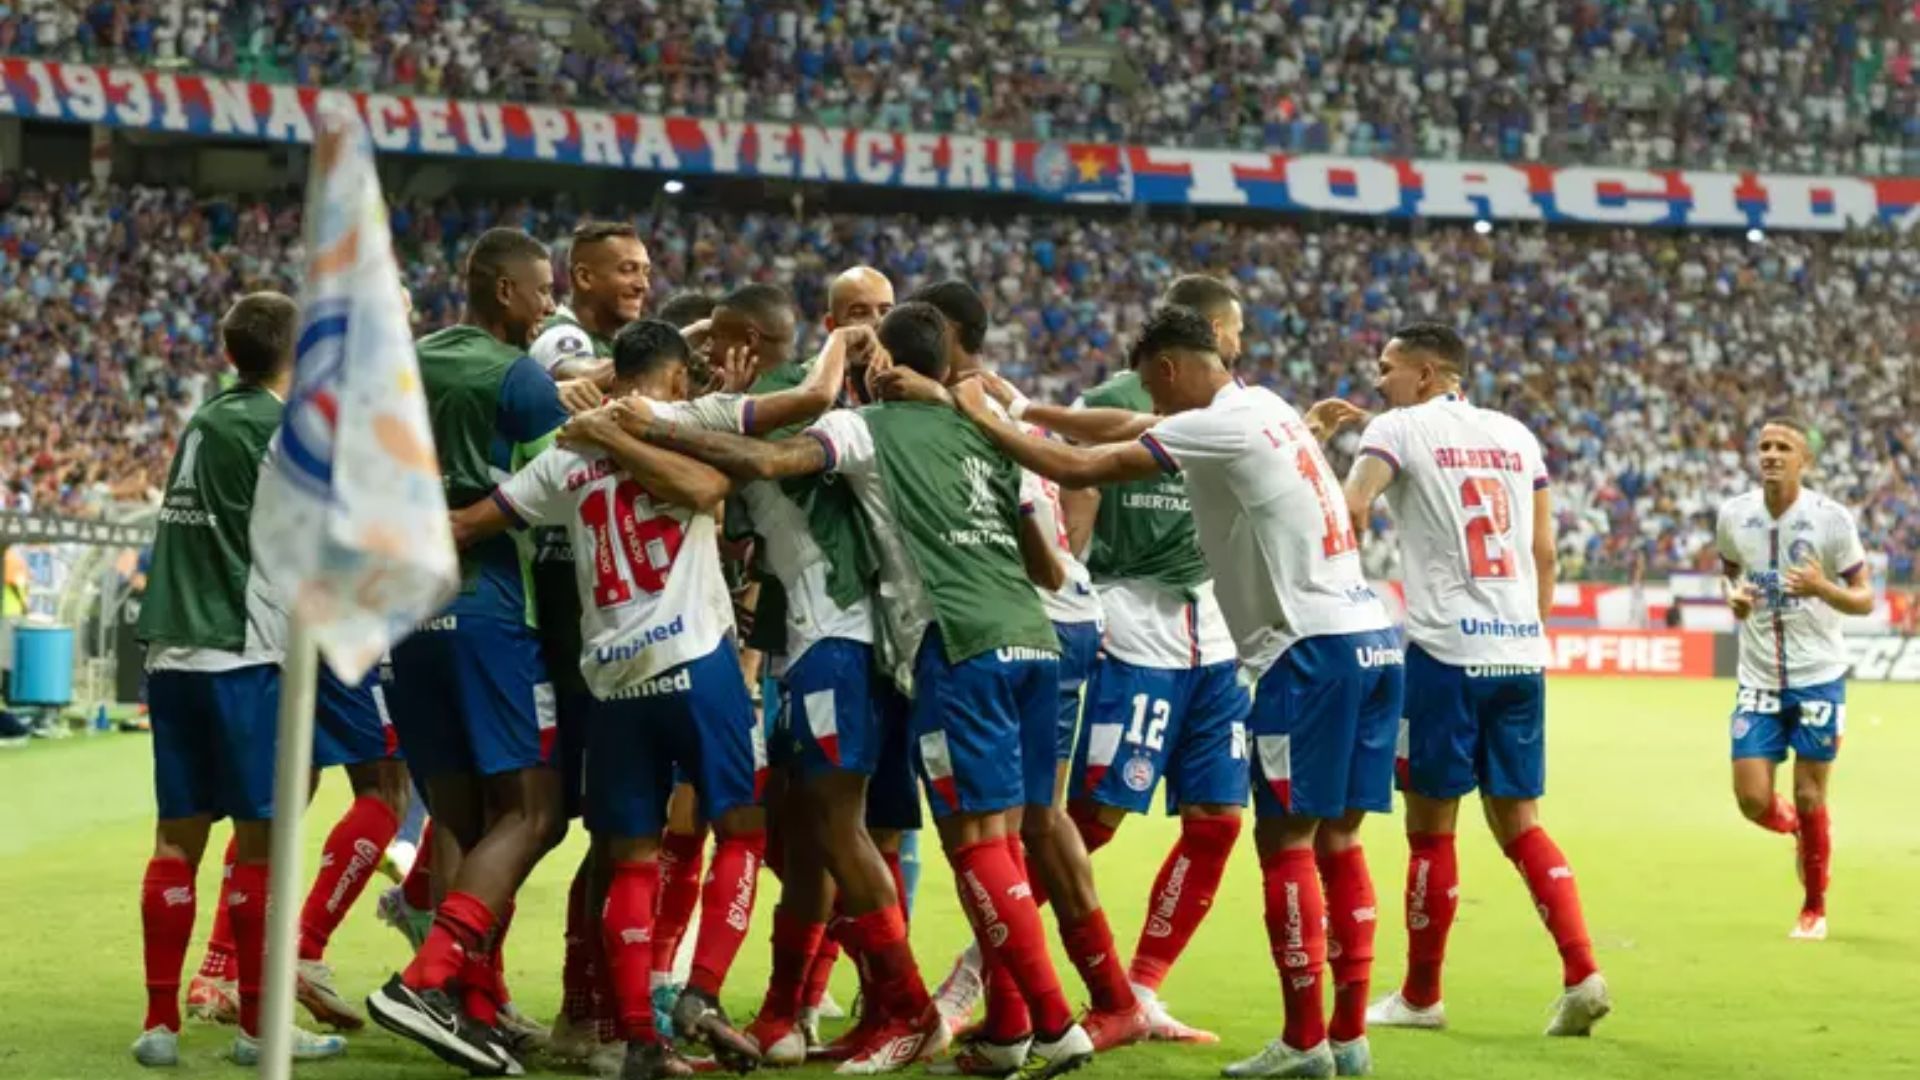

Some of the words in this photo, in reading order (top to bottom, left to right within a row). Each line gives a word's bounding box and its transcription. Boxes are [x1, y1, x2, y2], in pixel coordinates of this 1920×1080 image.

[28, 60, 190, 131] 1931
[204, 76, 507, 155] NACEU
[526, 106, 680, 170] PRA
[698, 116, 1015, 191] VENCER!
[578, 479, 684, 605] 16
[1459, 475, 1518, 579] 2
[1460, 617, 1539, 638] Unimed
[1125, 692, 1171, 752] 12
